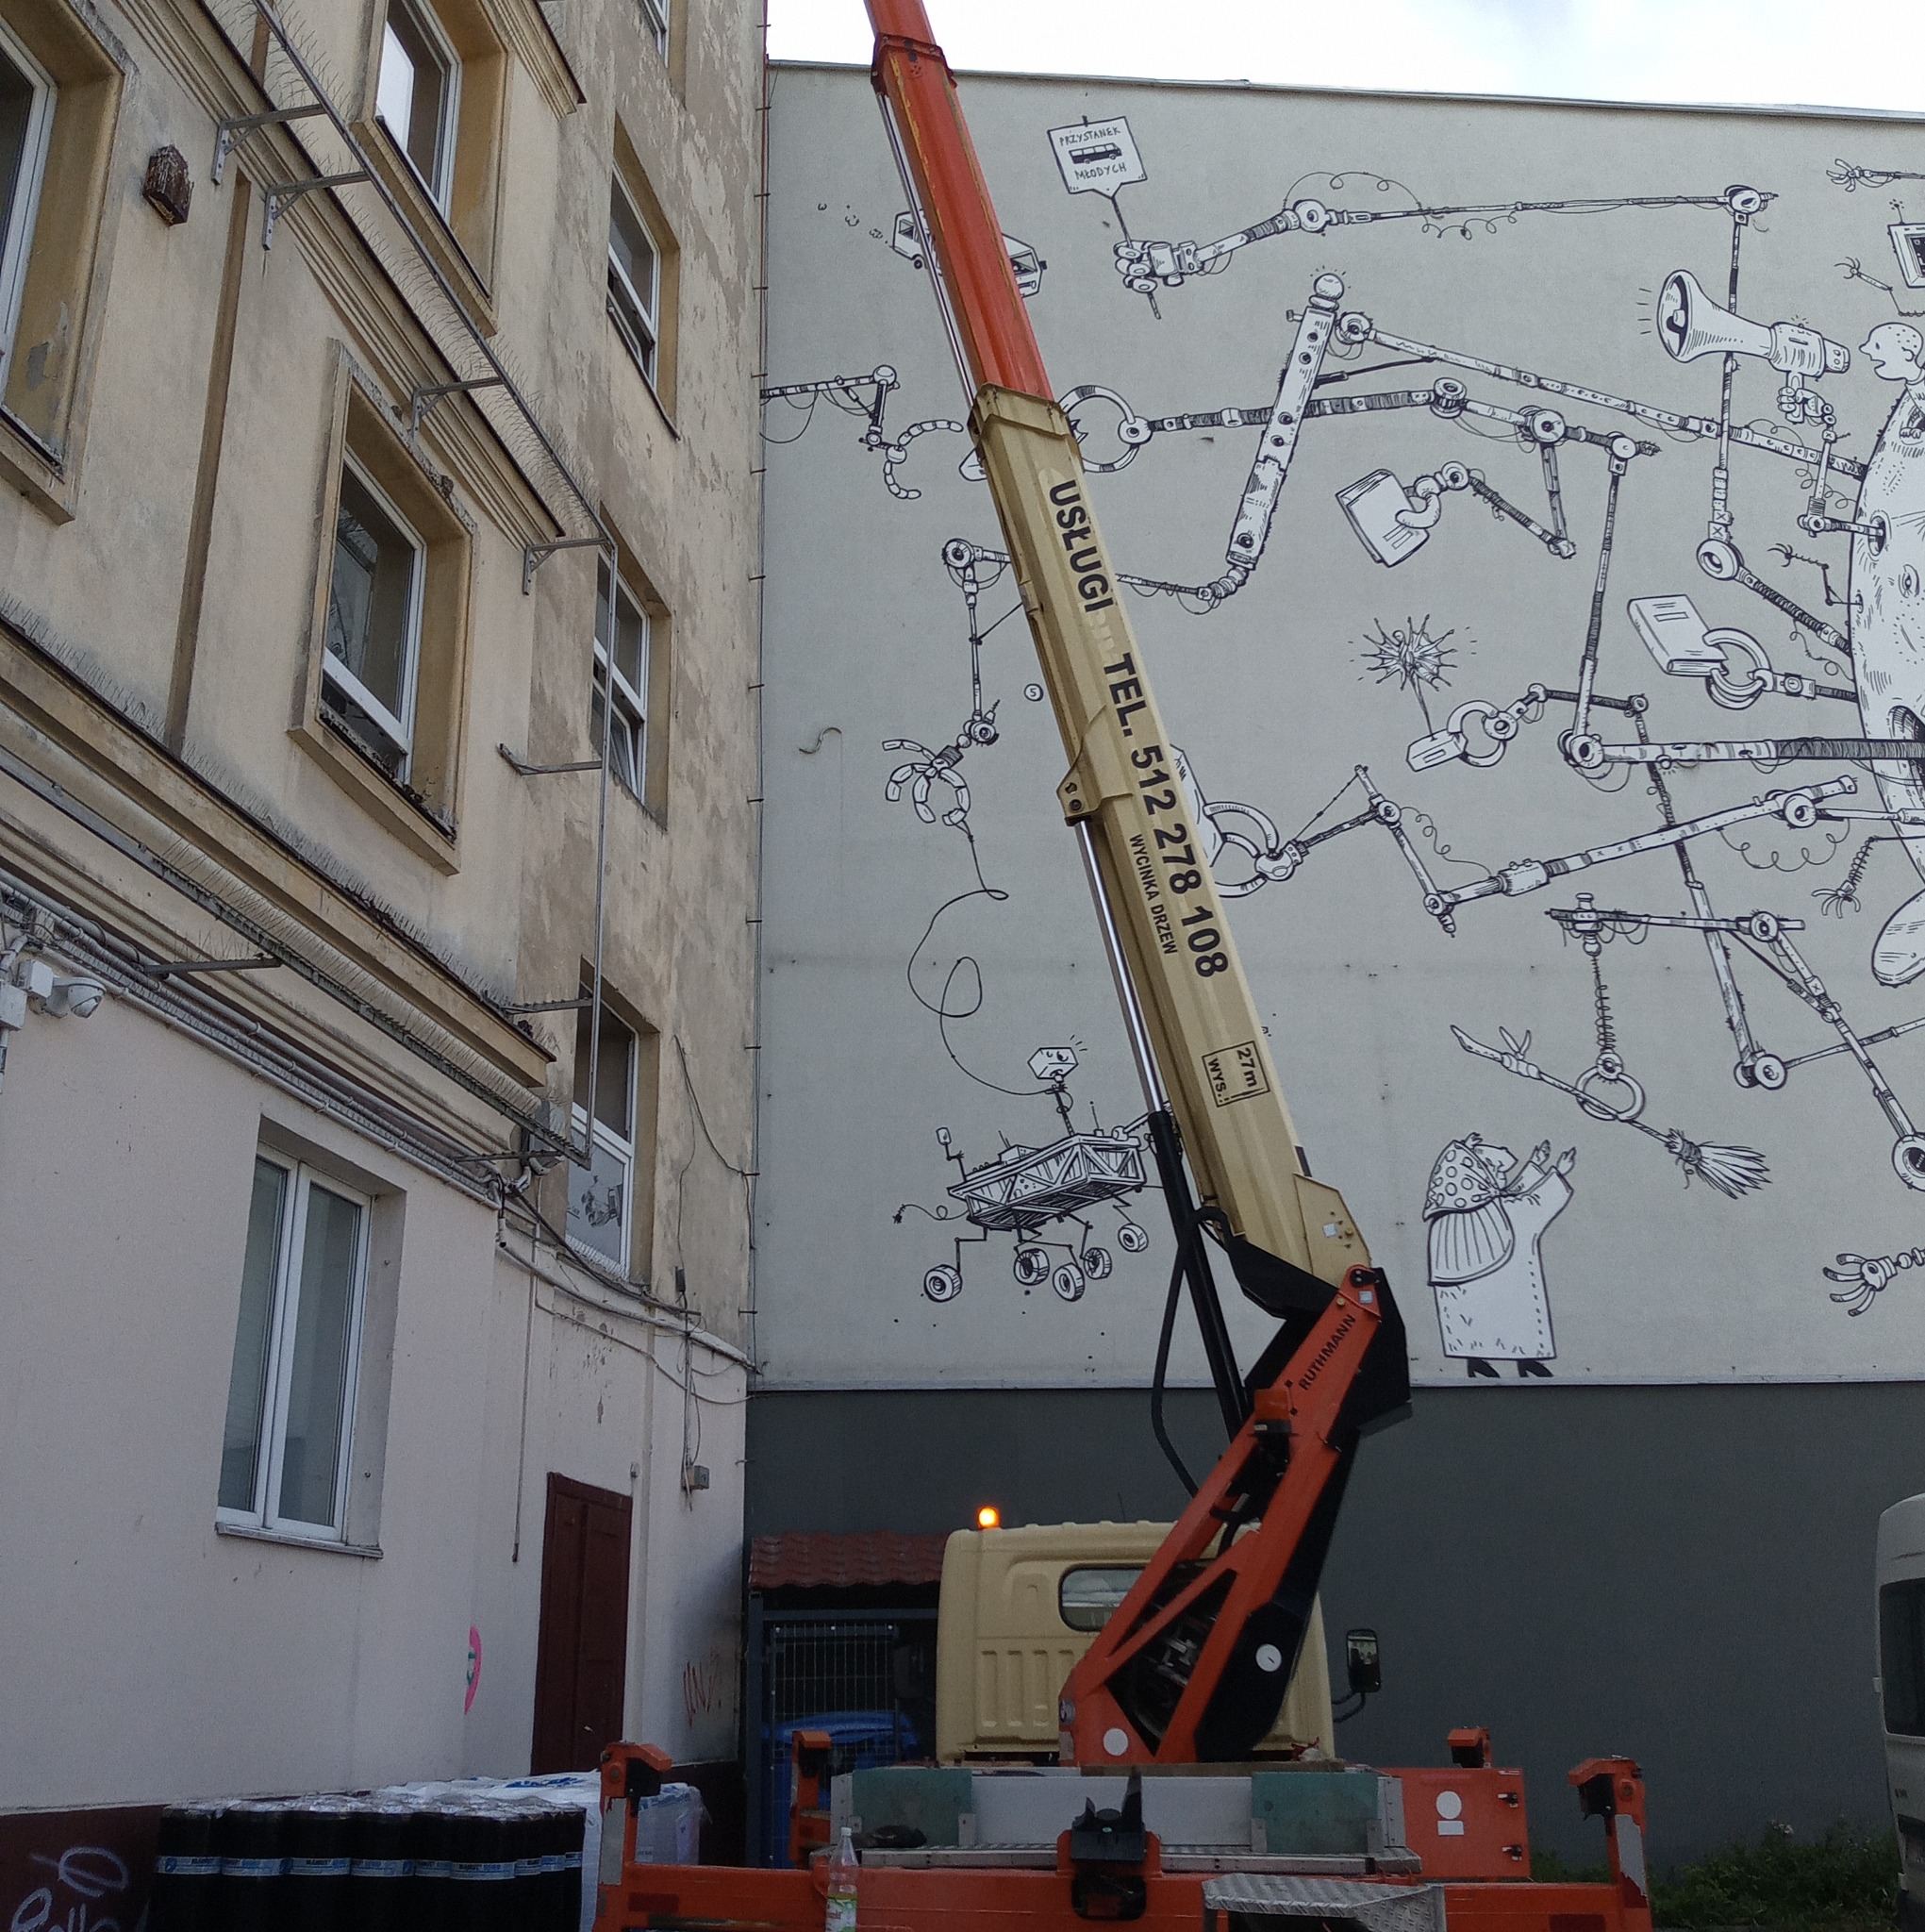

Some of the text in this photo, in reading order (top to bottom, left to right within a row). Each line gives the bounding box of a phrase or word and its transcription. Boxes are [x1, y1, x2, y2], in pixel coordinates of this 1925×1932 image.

[1059, 126, 1120, 146] PRZYSTANEK
[1074, 162, 1127, 180] MŁODYCH
[1050, 479, 1114, 613] USŁUGI
[1104, 652, 1147, 737] TEL.
[1131, 745, 1177, 816] 512
[1129, 834, 1178, 955] WYCINKA DRZEW
[1153, 823, 1202, 894] 278
[1181, 905, 1228, 977] 108
[1299, 1313, 1356, 1391] RUTHMANN
